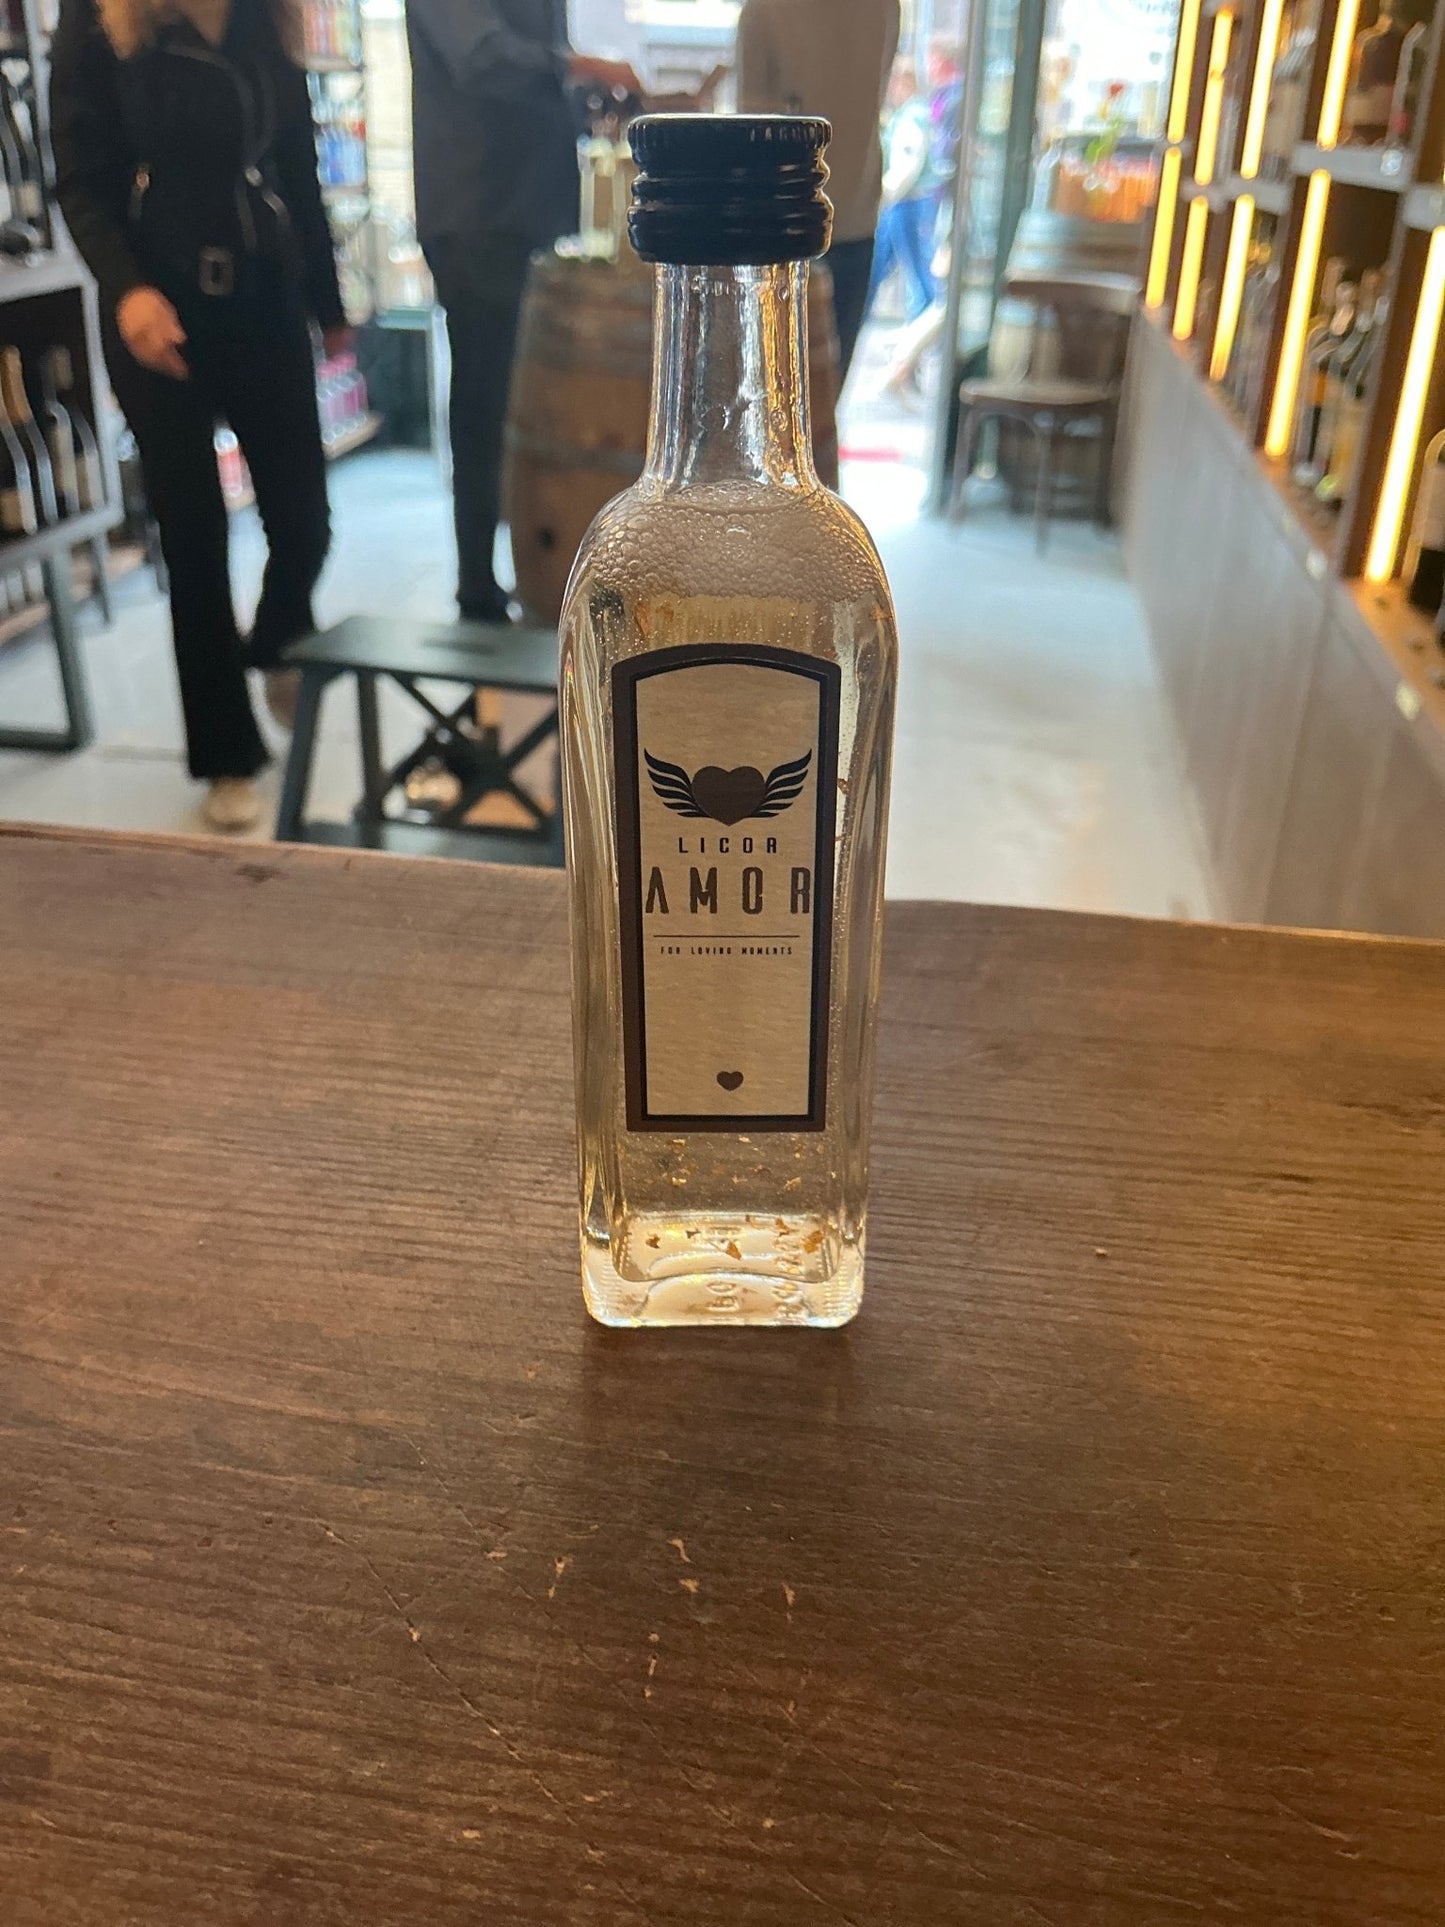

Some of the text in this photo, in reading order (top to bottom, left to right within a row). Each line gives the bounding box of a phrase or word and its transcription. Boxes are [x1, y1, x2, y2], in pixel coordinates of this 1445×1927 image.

[678, 836, 777, 854] LICOR
[645, 866, 811, 914] AMOR
[660, 946, 793, 955] FOR LOVING MOMENTS
